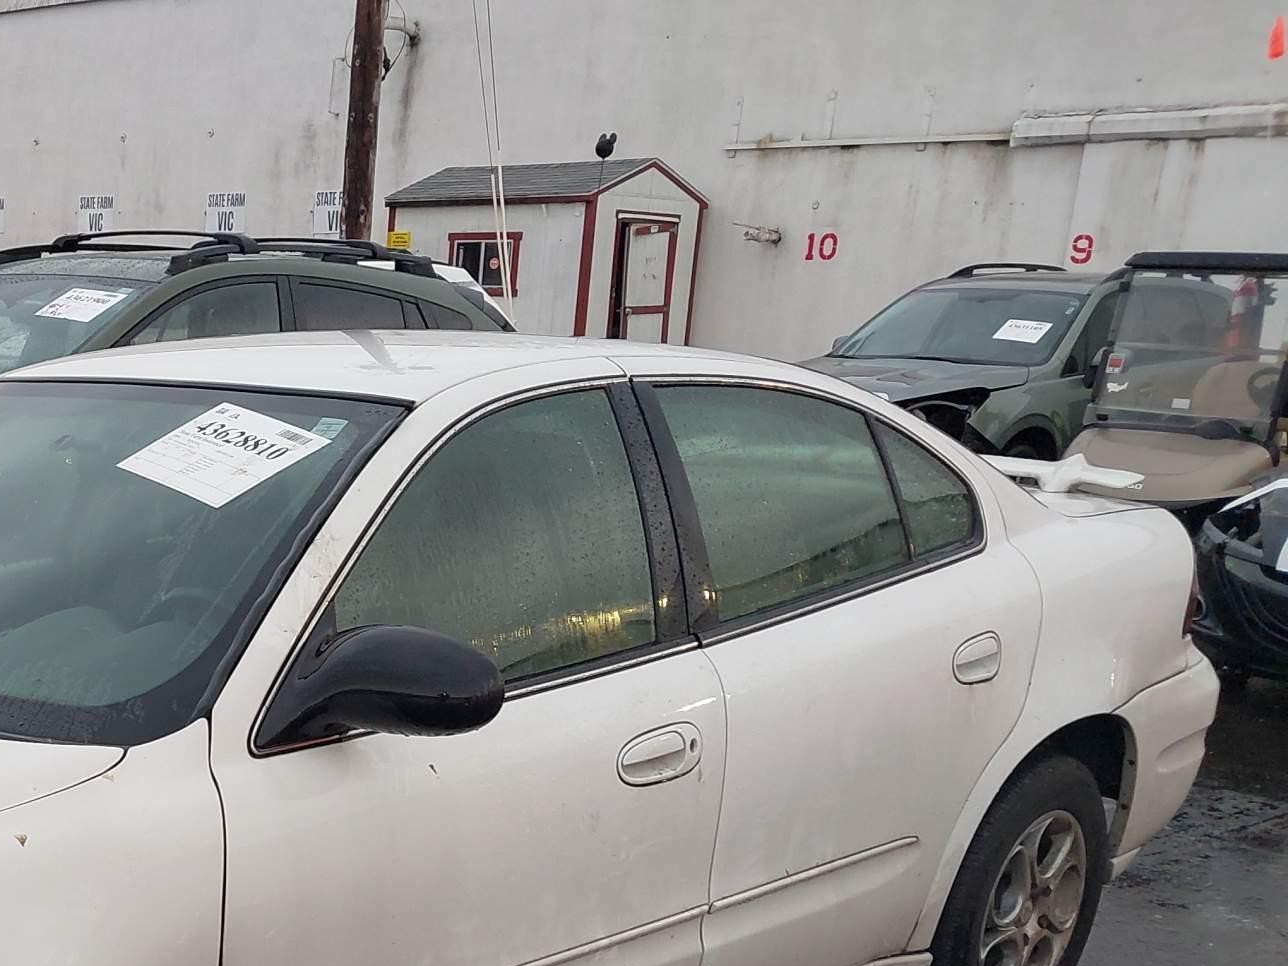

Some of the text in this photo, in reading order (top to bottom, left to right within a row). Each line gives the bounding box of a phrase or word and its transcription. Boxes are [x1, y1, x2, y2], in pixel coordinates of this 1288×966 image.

[79, 196, 114, 210] STATE FARM
[207, 192, 246, 208] STATE FARM
[316, 191, 337, 207] STATE
[88, 212, 103, 232] VIC
[217, 210, 234, 231] VIC
[327, 210, 339, 232] VI
[805, 232, 838, 261] 10
[1070, 234, 1094, 264] 9
[195, 420, 290, 461] 43628810
